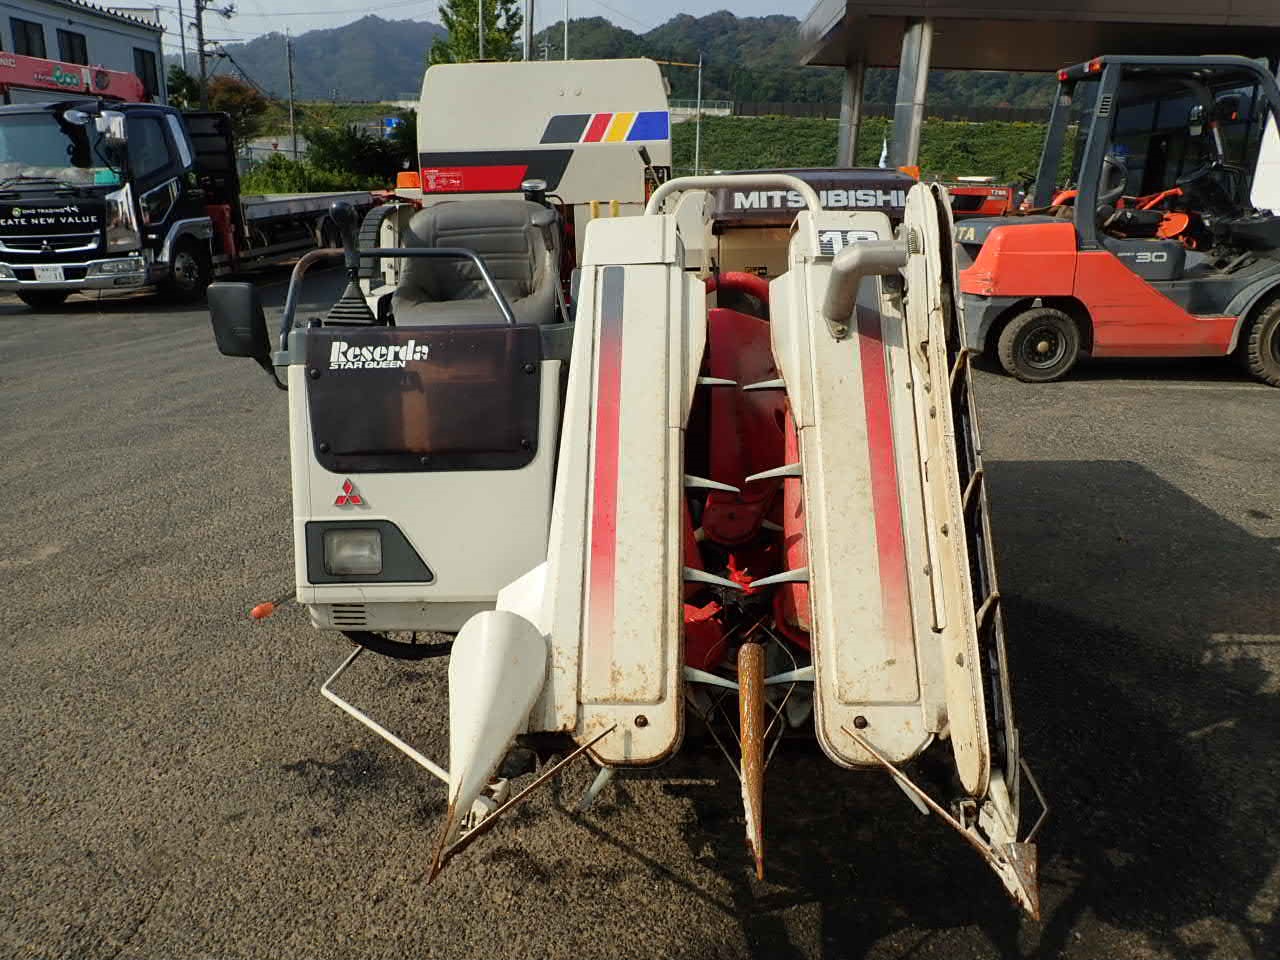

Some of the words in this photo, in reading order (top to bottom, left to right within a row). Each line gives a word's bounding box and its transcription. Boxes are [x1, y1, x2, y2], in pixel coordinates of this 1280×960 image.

[31, 217, 55, 225] NEW
[60, 215, 98, 223] VALUE
[1135, 251, 1168, 263] 30
[329, 340, 430, 362] Reserda
[329, 361, 363, 370] STAR
[364, 360, 407, 369] QUEEN
